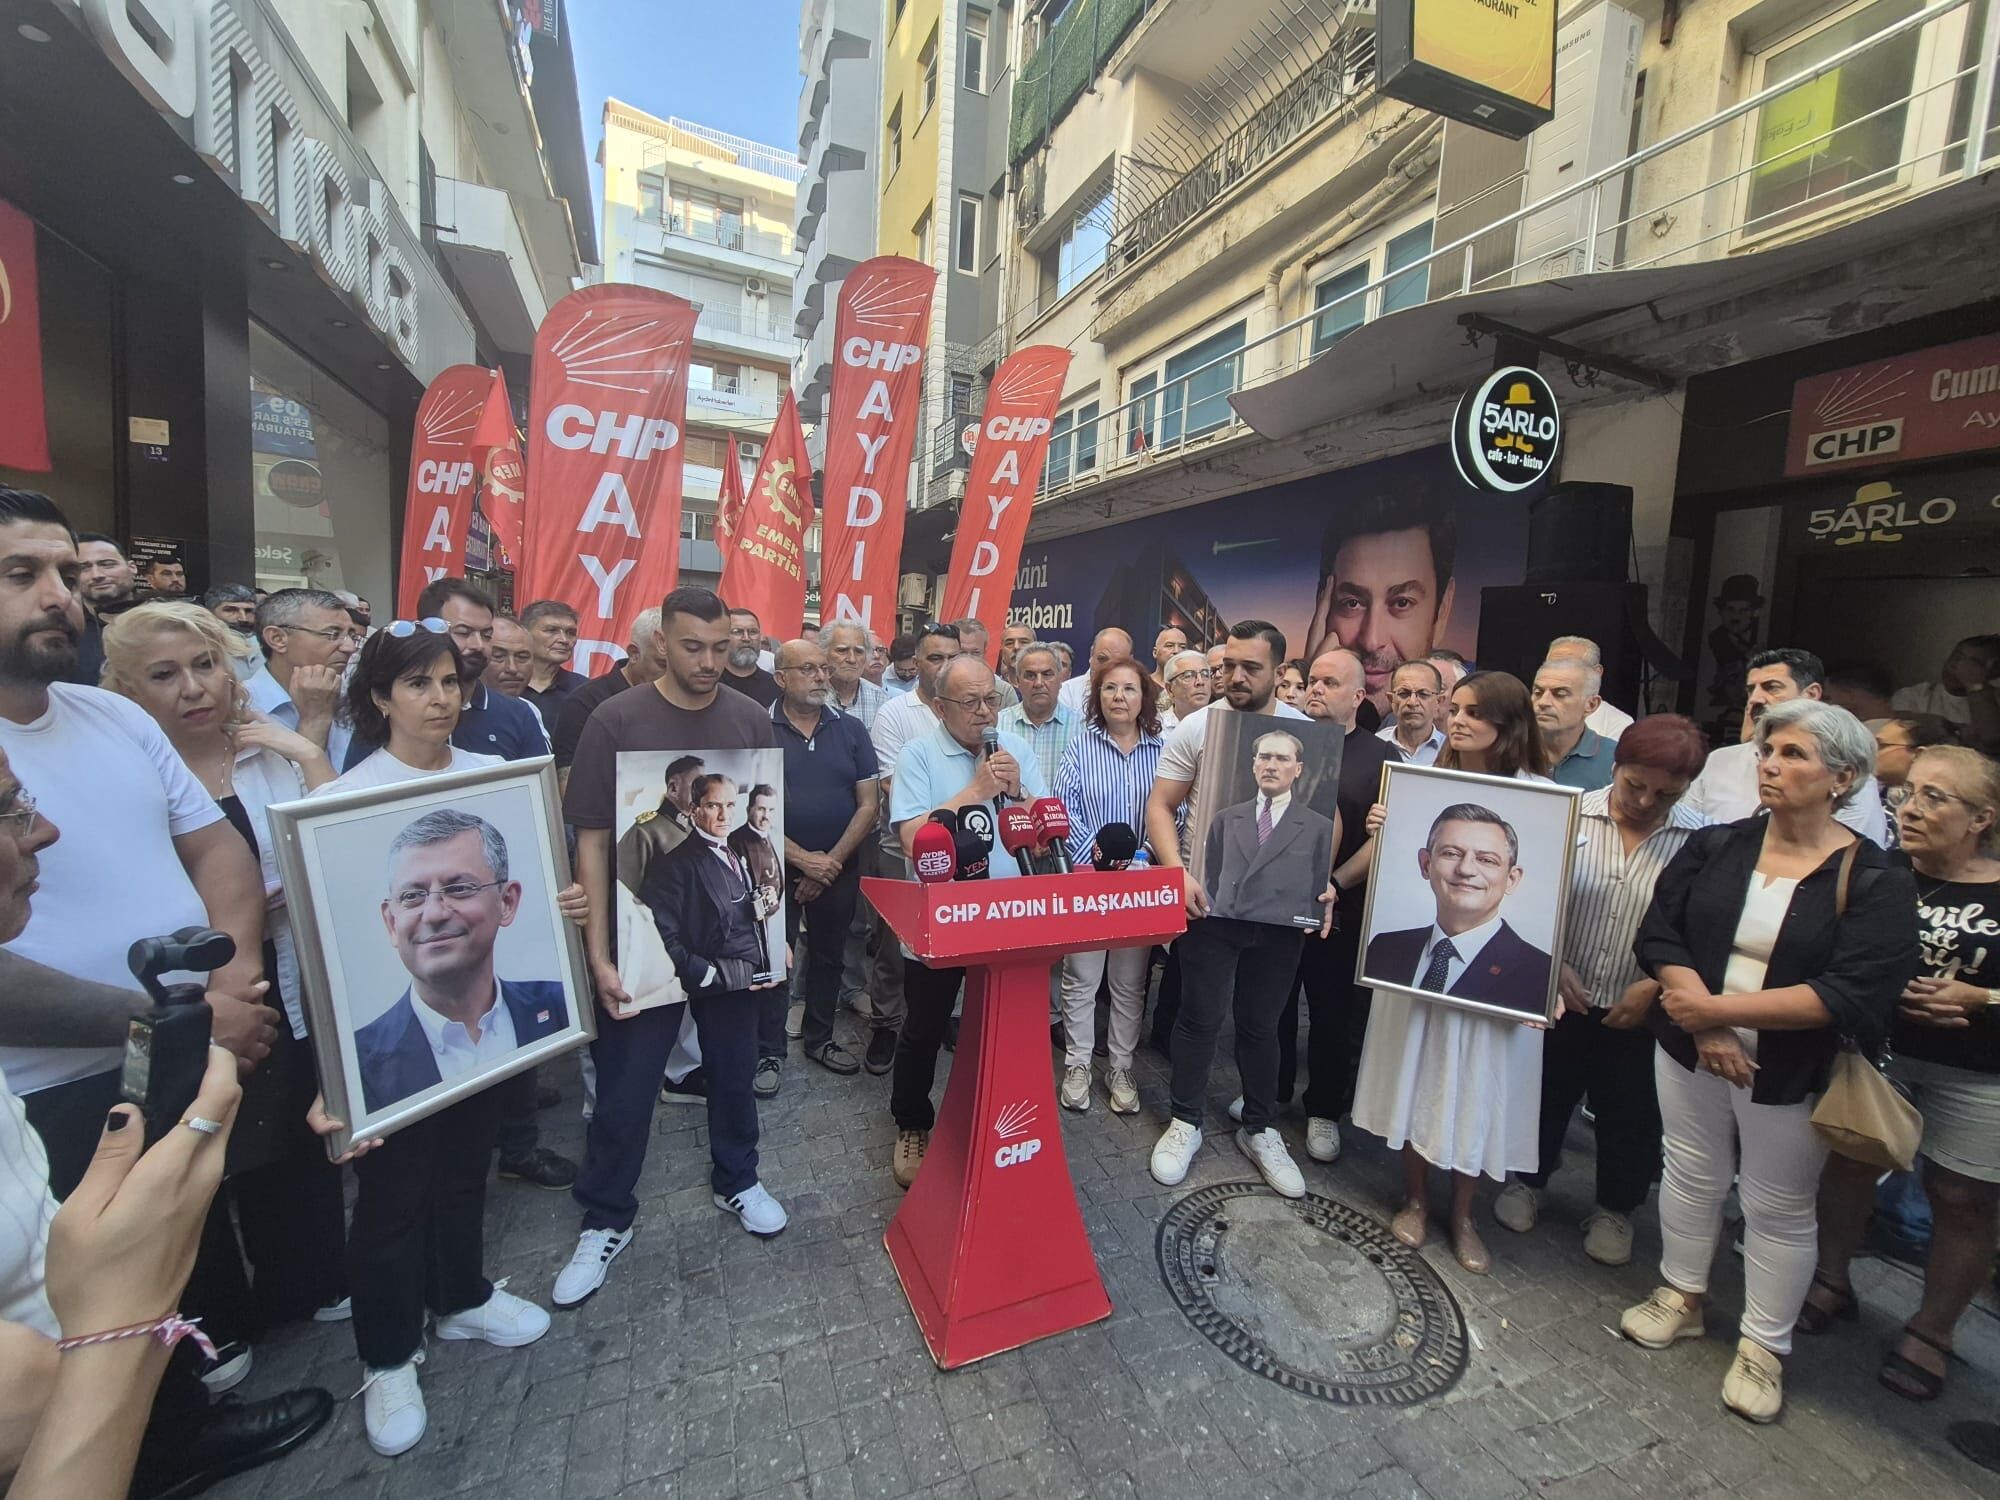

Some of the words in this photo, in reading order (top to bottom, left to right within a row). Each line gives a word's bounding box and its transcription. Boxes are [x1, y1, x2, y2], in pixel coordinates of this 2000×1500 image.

[1473, 0, 1519, 20] URANT
[842, 336, 921, 373] CHP
[546, 404, 680, 461] CHP
[986, 415, 1050, 442] CHP
[1813, 425, 1896, 460] CHP
[150, 446, 163, 456] 13
[1487, 448, 1503, 462] cafe
[417, 459, 474, 496] CHP
[920, 857, 950, 871] SES
[921, 850, 947, 859] AYDIN
[935, 903, 980, 924] CHP
[986, 899, 1046, 920] AYDIN
[1052, 893, 1068, 915] İL
[1073, 885, 1179, 916] BAŞKANLIĞI
[995, 1138, 1042, 1168] CHP
